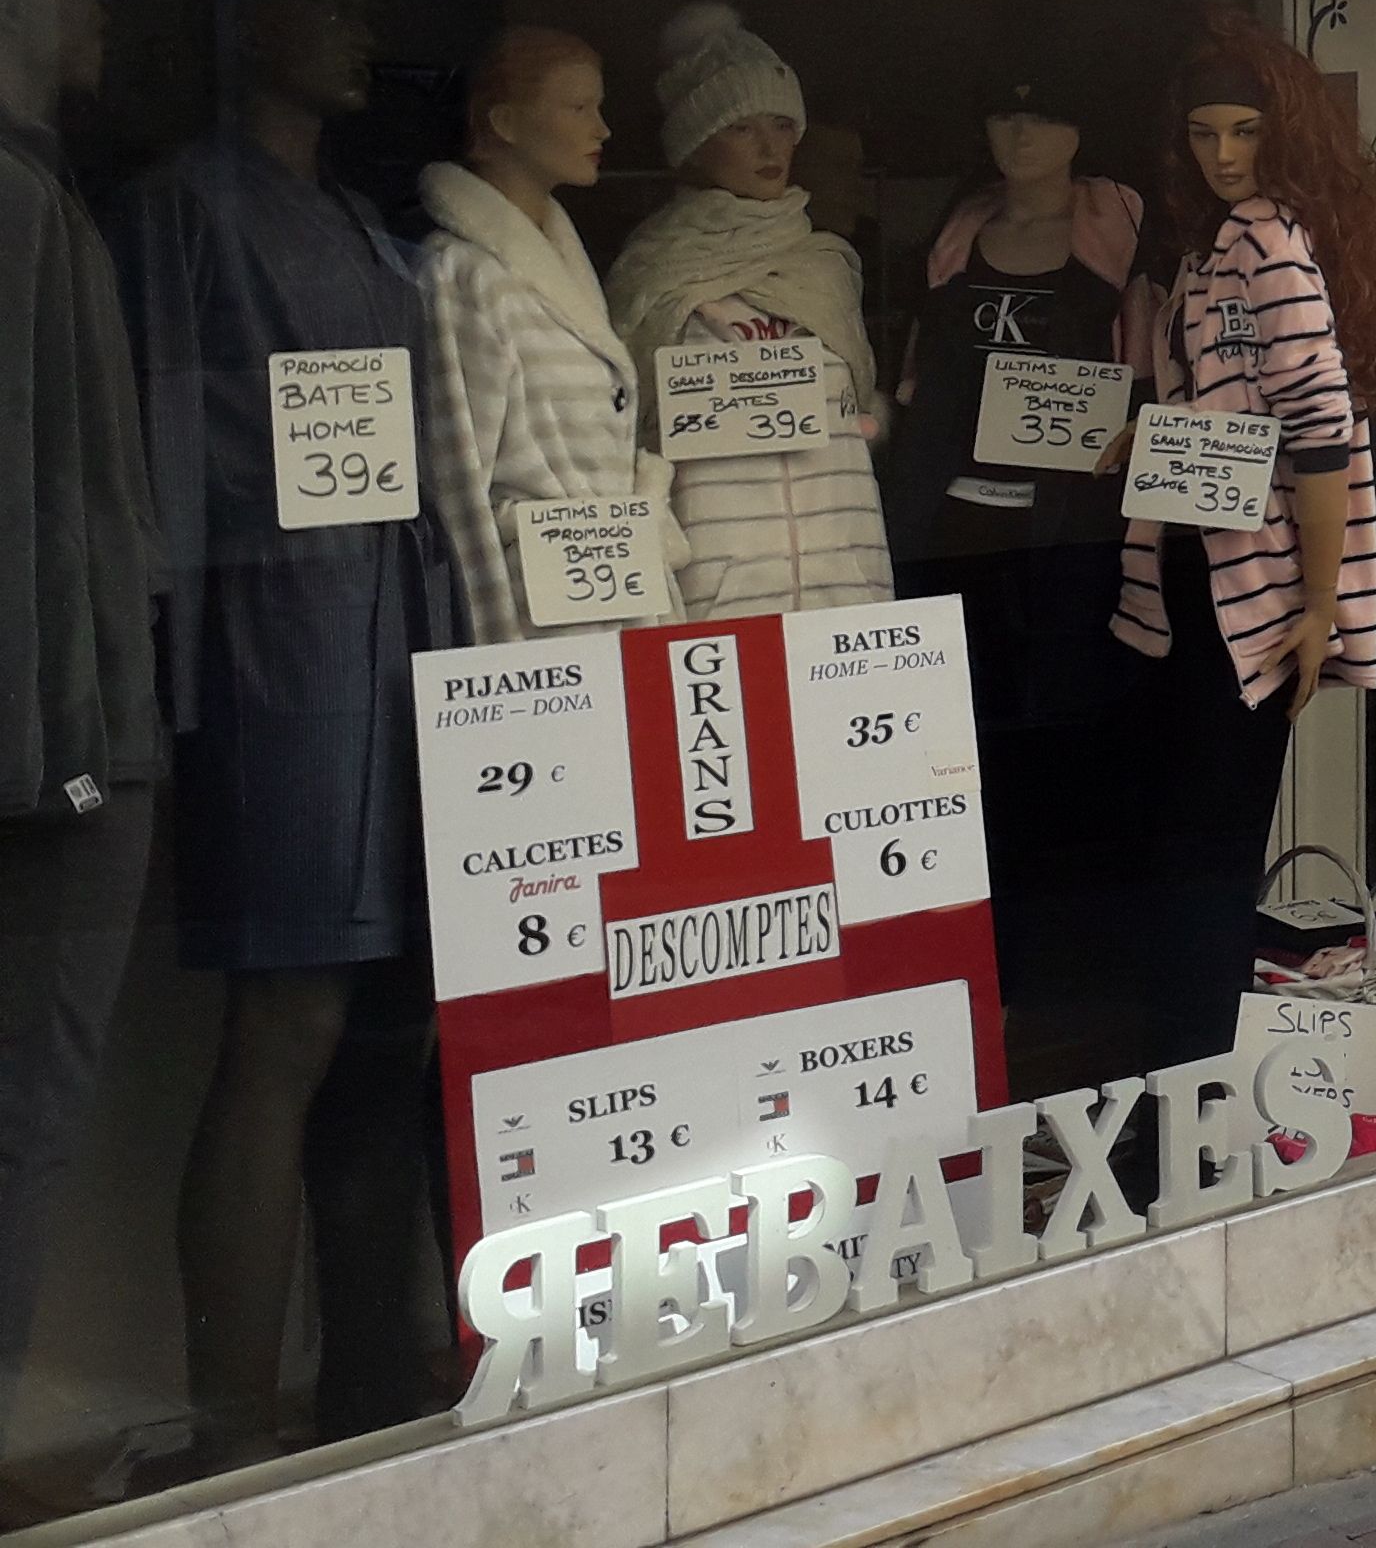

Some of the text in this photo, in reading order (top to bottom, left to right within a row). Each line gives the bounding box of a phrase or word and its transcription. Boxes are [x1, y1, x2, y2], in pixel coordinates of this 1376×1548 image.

[281, 354, 383, 374] PROMOCIÓ
[671, 345, 804, 369] ULTIMS DIES
[995, 360, 1122, 381] ULTIMS DIES
[668, 365, 817, 388] GRANS DESCOMPTES
[279, 383, 393, 408] BATES
[708, 392, 779, 412] BATES
[1025, 396, 1089, 414] BATES
[288, 417, 375, 440] HOME
[747, 410, 822, 439] 39€
[1011, 415, 1108, 450] 35€
[1149, 414, 1269, 437] ULTIMS DIES
[1150, 435, 1192, 449] GRANS
[298, 453, 404, 497] 39€
[1170, 460, 1232, 480] BATES
[532, 501, 650, 524] ULTIMS DIES
[1197, 483, 1258, 517] 39€
[564, 542, 630, 561] BATES
[566, 565, 647, 601] 39€
[833, 625, 921, 654] BATES
[809, 658, 868, 682] HOME
[893, 649, 946, 671] DONA
[444, 665, 582, 701] PIJAMES
[436, 703, 504, 729] HOME
[533, 694, 594, 716] DONA
[683, 643, 737, 836] GRANS
[847, 712, 921, 748] 35 €
[477, 761, 566, 795] 29 €
[824, 794, 967, 835] CULOTTES
[463, 831, 623, 876] CALCETES
[880, 838, 938, 877] 6 €
[509, 873, 581, 902] Janira
[518, 914, 586, 956] 8 €
[613, 890, 832, 992] DESCOMPTES
[1268, 1003, 1352, 1037] SLIPS
[800, 1031, 913, 1073] BOXERS
[568, 1084, 656, 1123] SLIPS
[855, 1073, 929, 1110] 14 €
[608, 1123, 691, 1165] 13 €
